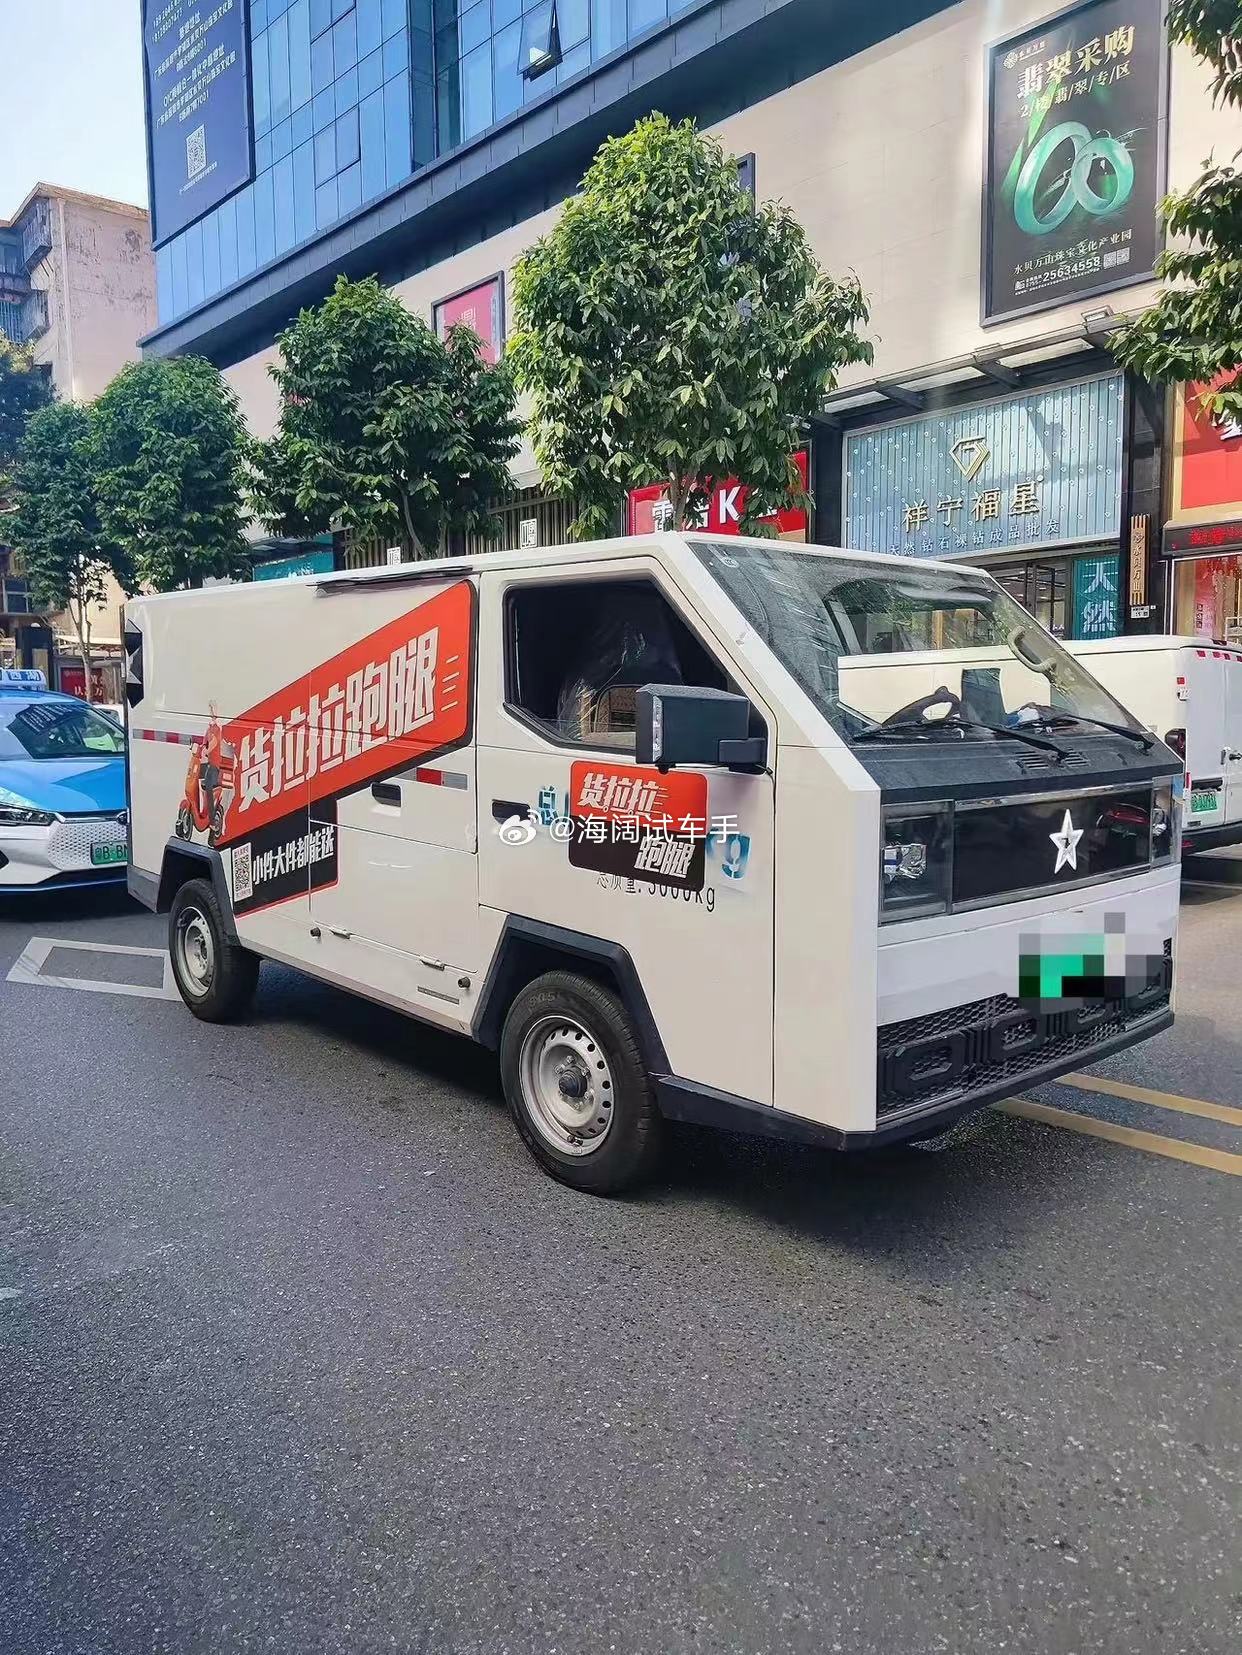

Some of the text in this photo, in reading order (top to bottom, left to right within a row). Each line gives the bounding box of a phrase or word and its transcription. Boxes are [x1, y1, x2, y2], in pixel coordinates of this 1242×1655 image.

[1017, 25, 1135, 99] 翡翠采购
[1043, 256, 1101, 282] 25634558
[901, 480, 1041, 533] 祥宁福星
[888, 519, 1061, 557] 天然钻石裸钻成品批发
[238, 626, 439, 813] 货拉拉跑腿
[577, 772, 661, 816] 货拉拉
[253, 825, 335, 885] 小件大件都能送
[634, 836, 697, 879] 跑腿
